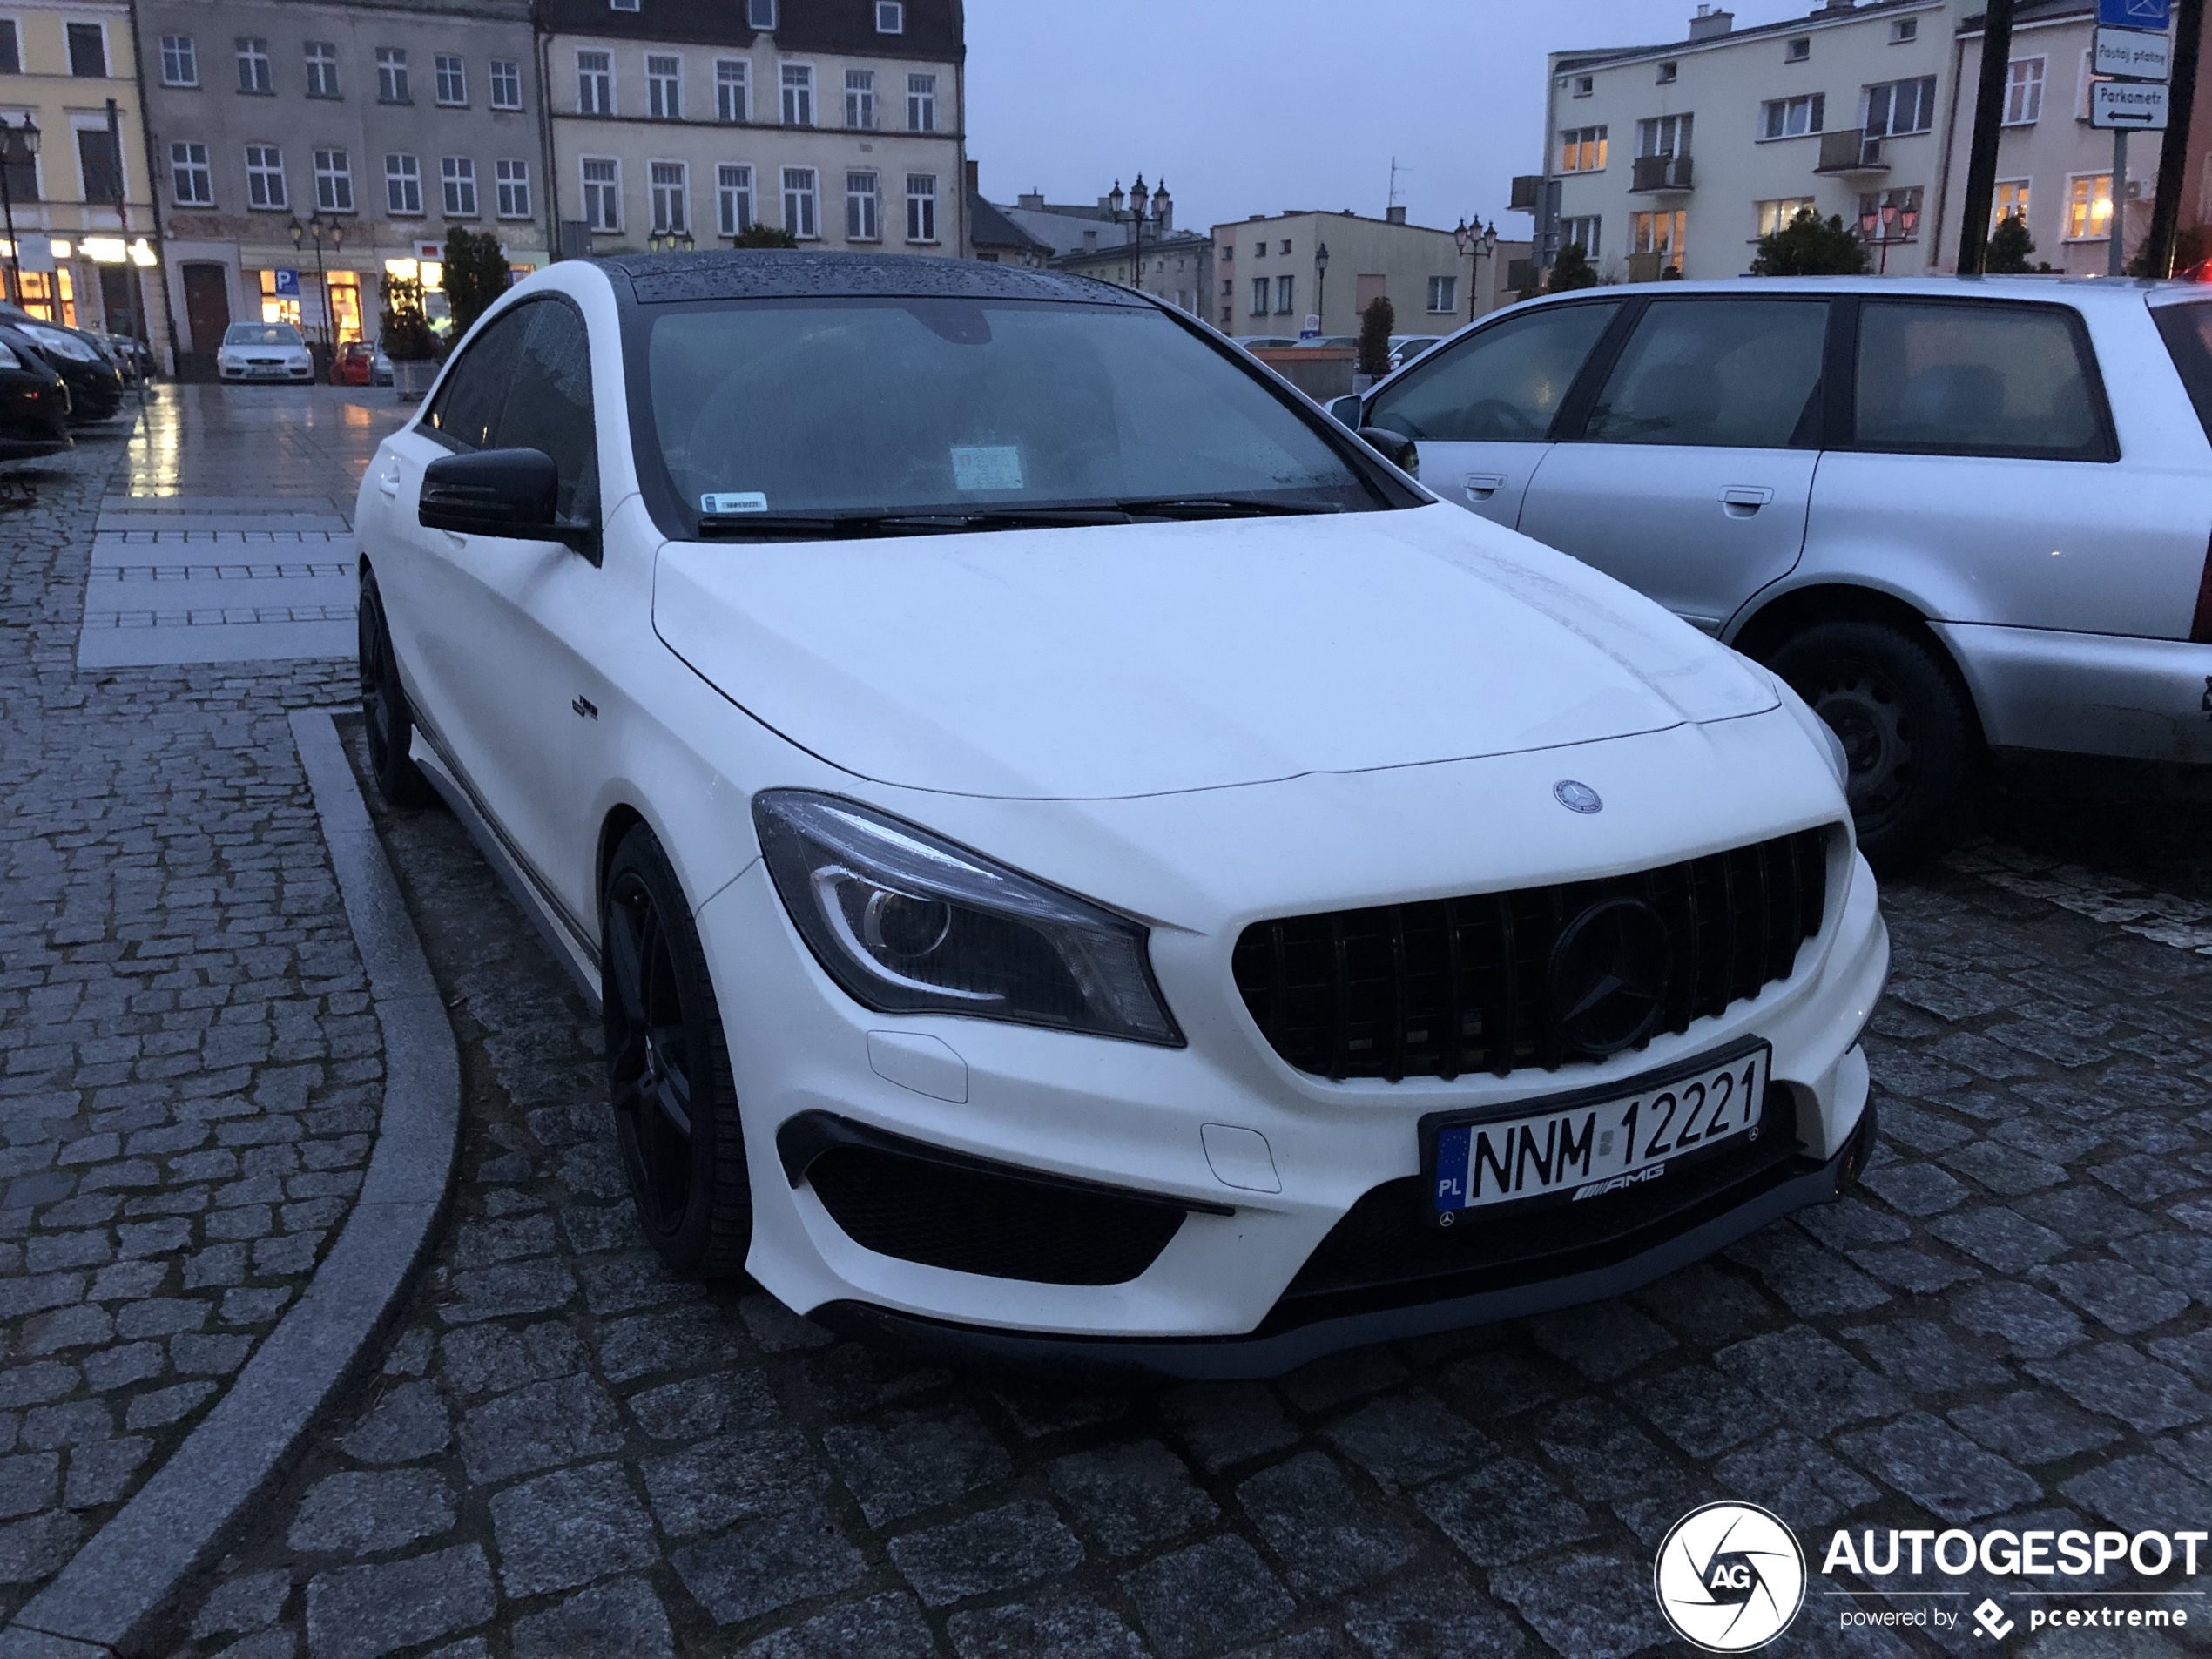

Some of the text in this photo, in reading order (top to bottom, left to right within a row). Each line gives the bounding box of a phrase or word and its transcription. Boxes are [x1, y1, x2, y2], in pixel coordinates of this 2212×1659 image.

[2101, 88, 2162, 105] Parkometr
[277, 271, 291, 290] P
[1472, 1060, 1757, 1199] NNM 12221
[1439, 1177, 1462, 1198] PL
